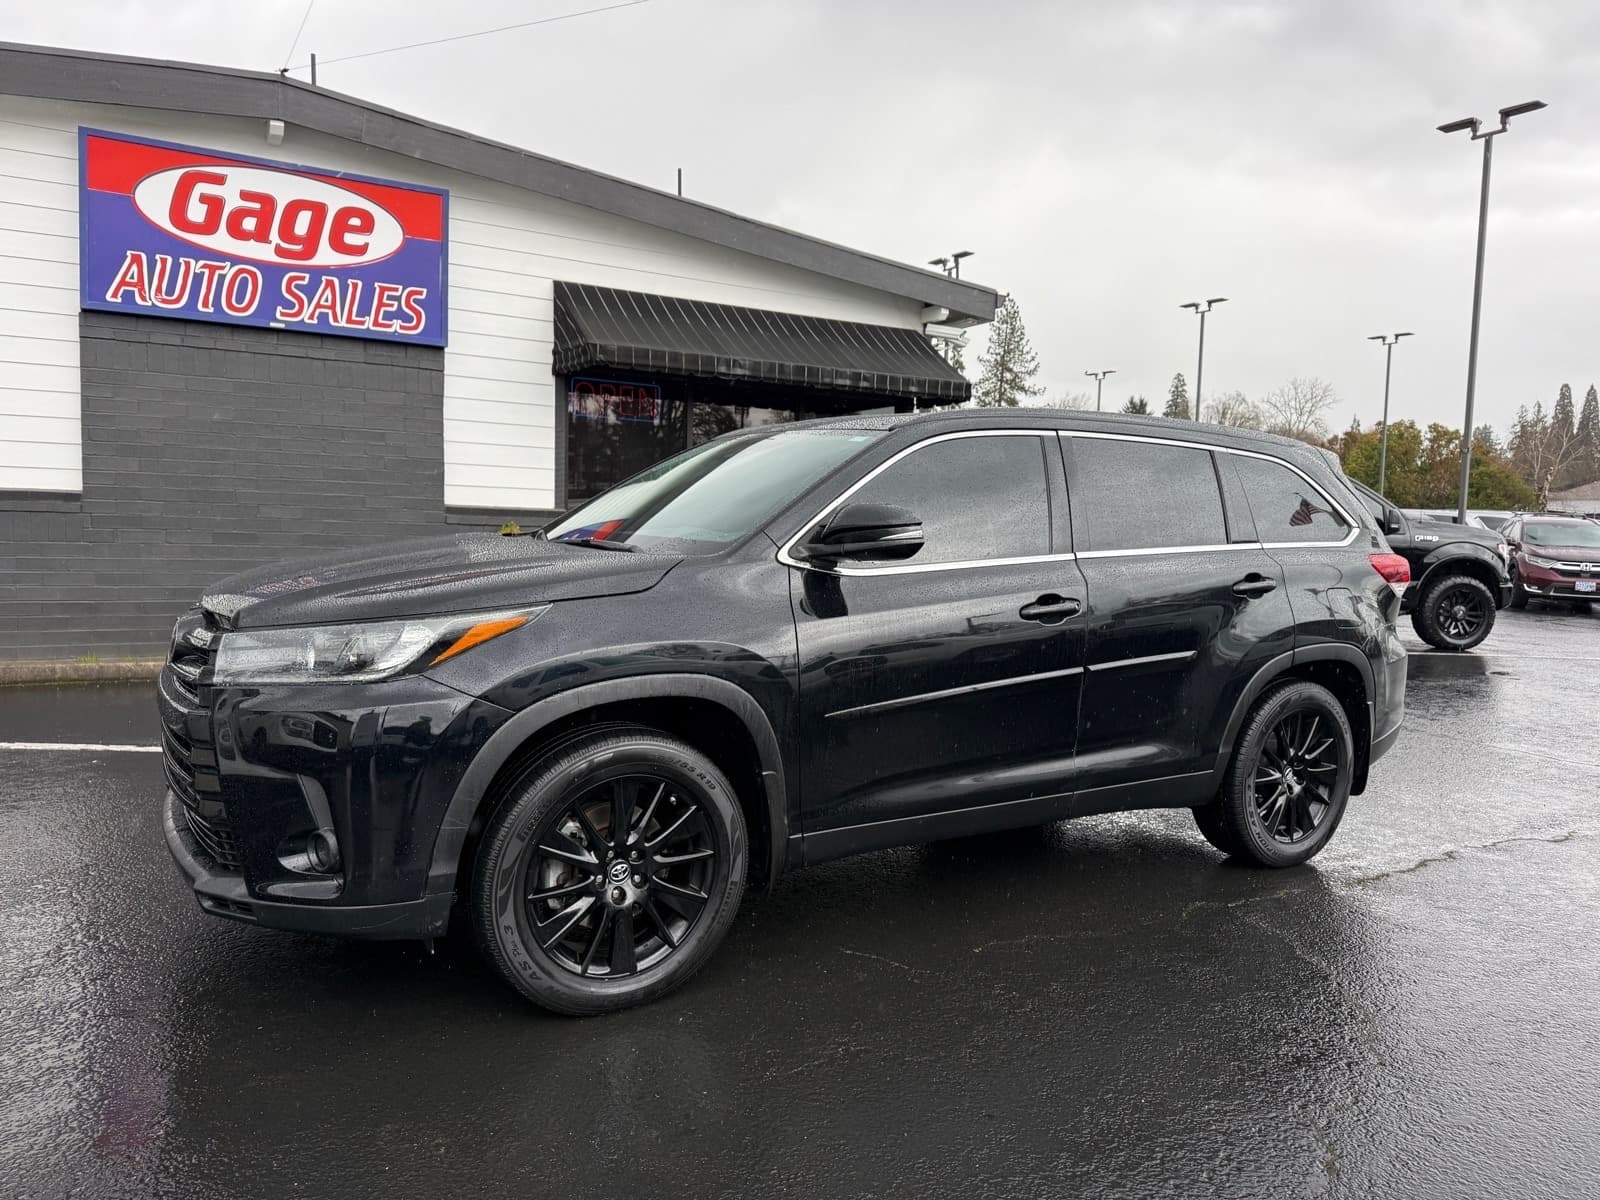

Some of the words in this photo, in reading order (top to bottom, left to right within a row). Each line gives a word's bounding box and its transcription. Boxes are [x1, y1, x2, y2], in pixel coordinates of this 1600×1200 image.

[168, 169, 376, 261] Gage
[105, 250, 263, 317] AUTO
[276, 271, 427, 335] SALES
[574, 382, 657, 417] OPEN
